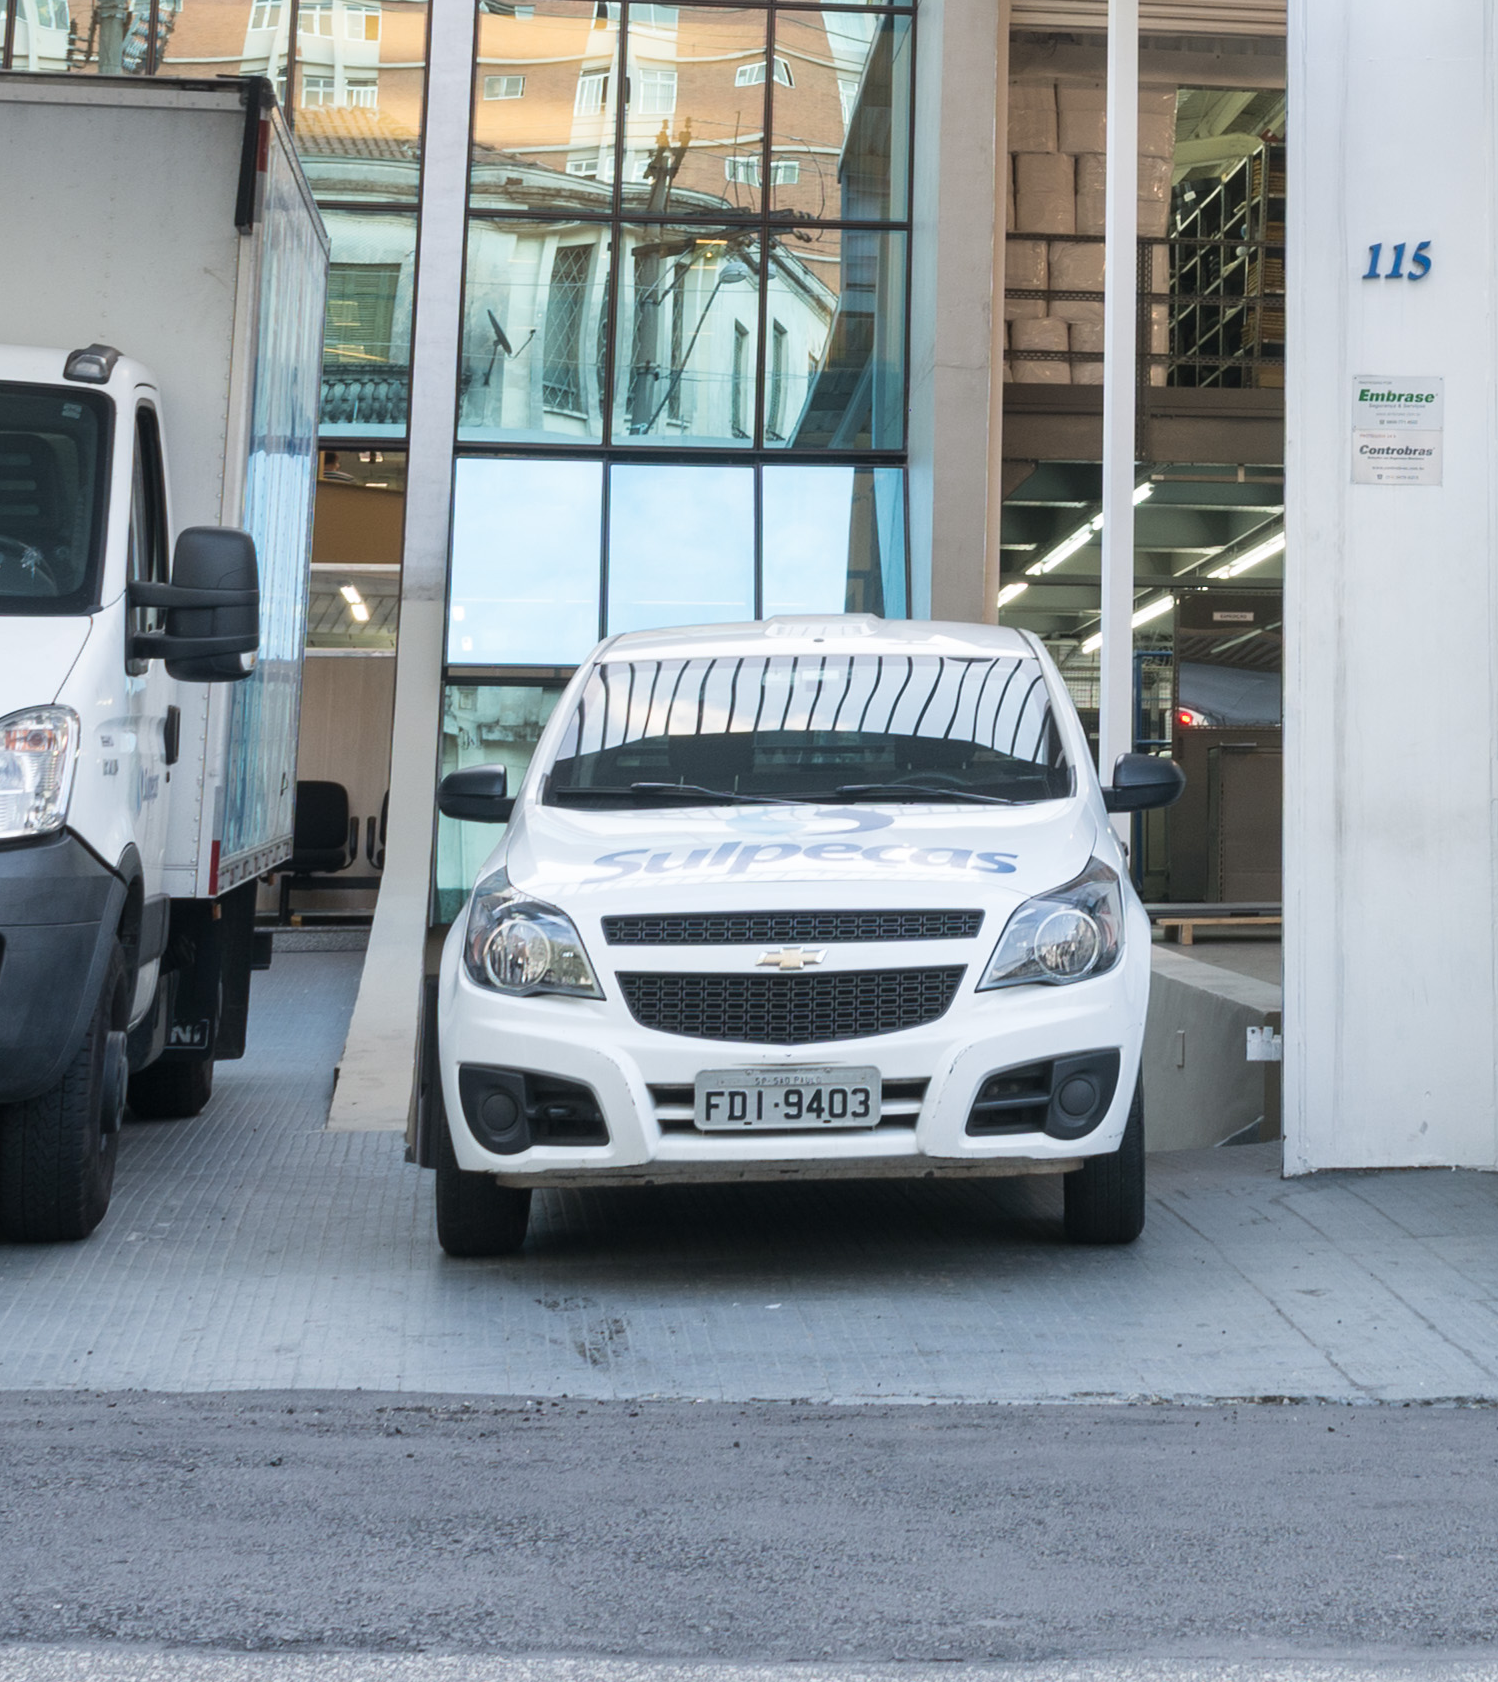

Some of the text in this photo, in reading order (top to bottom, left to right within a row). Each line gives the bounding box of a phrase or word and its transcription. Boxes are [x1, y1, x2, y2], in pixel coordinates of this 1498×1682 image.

[1362, 240, 1432, 281] 115
[1358, 389, 1435, 403] Embrase
[1359, 445, 1433, 456] Controbras
